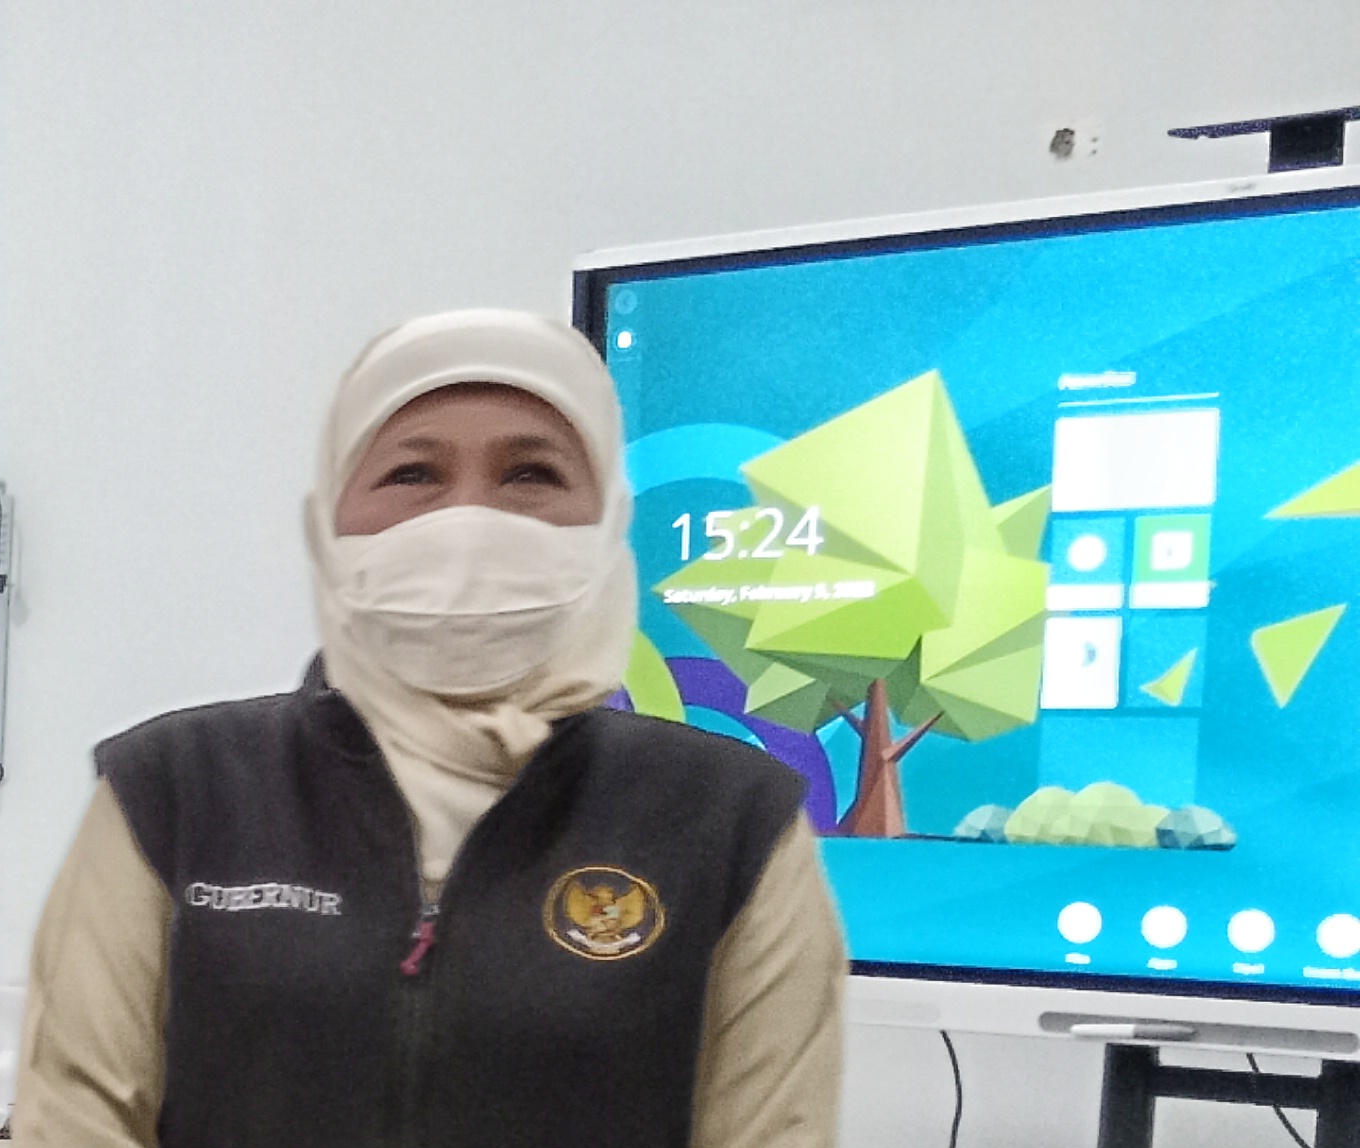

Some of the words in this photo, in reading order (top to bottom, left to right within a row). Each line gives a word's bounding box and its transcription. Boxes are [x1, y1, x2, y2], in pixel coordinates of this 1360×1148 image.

[672, 505, 824, 561] 15:24
[739, 584, 814, 603] February
[184, 881, 343, 916] GUBERNUR
